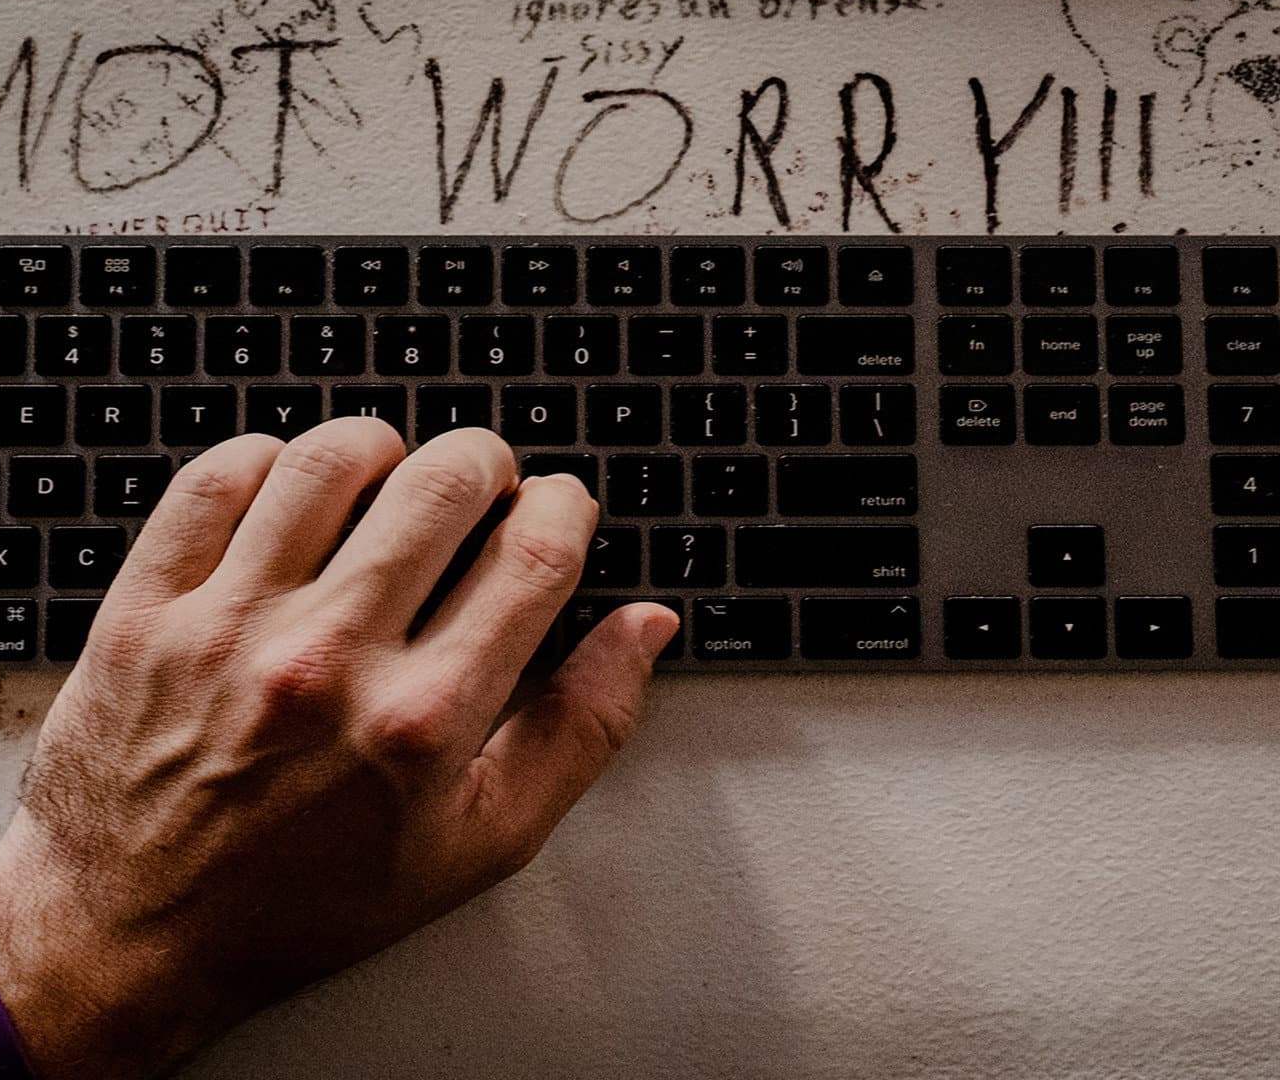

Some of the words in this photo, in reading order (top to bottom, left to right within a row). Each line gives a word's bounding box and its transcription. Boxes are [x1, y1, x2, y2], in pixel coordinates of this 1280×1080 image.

[1040, 338, 1082, 352] home
[1126, 331, 1163, 346] page
[1226, 338, 1262, 352] clear
[857, 353, 903, 367] delete
[955, 415, 1001, 429] delete
[1049, 408, 1077, 422] end
[1128, 415, 1168, 428] down
[860, 494, 906, 508] return
[872, 564, 907, 579] shift
[704, 637, 753, 652] option
[856, 637, 910, 651] control
